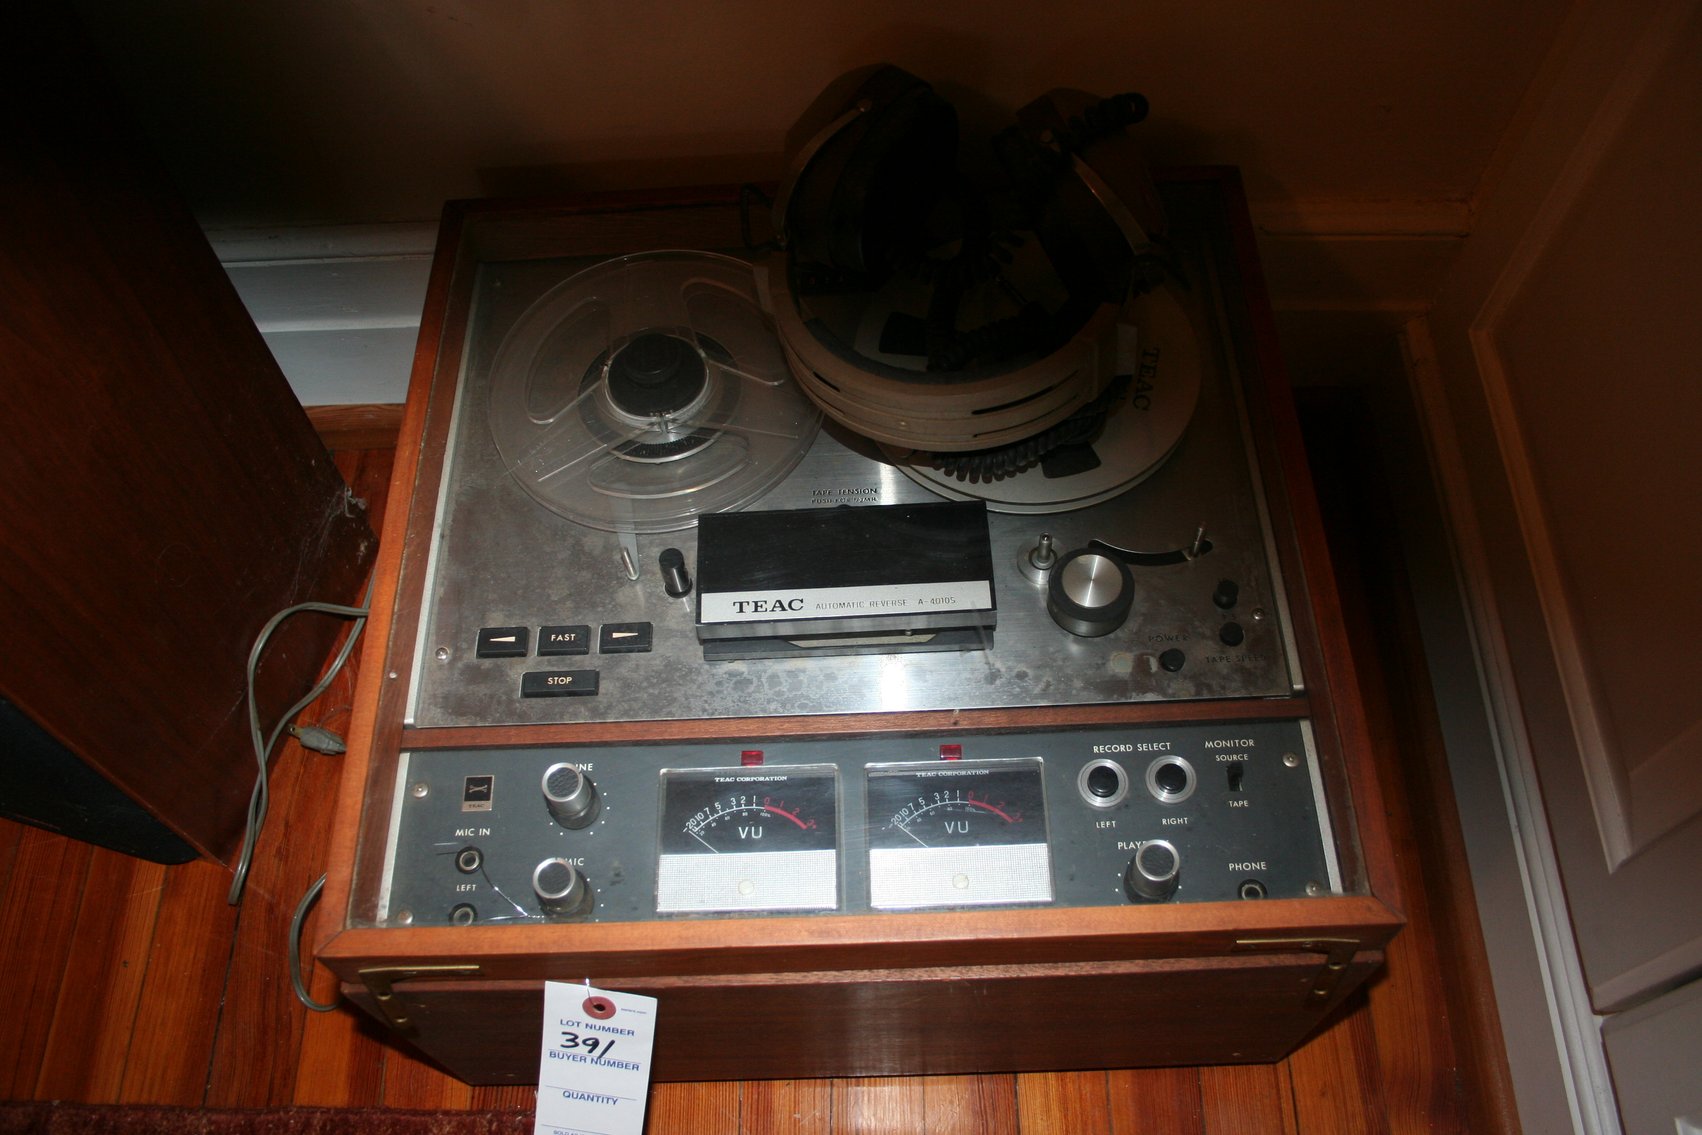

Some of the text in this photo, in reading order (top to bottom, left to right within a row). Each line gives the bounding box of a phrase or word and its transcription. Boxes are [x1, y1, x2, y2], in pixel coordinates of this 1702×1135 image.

[1133, 347, 1160, 411] TEAC
[811, 487, 878, 497] TAPE TENSION
[732, 597, 805, 614] TEAC
[815, 600, 865, 610] AUTOMATIC
[869, 599, 908, 608] REVERSE
[550, 633, 576, 642] FAST
[1149, 633, 1190, 643] POWER
[1205, 654, 1232, 664] TAPE
[547, 676, 573, 685] STOP
[1093, 742, 1171, 754] RECORD SELECT
[1204, 738, 1255, 749] MONITOR
[1215, 753, 1249, 762] SOURCE
[938, 769, 990, 777] CORPORATION
[694, 812, 705, 822] 10
[703, 807, 711, 815] 7
[714, 802, 722, 810] 5
[730, 797, 737, 805] 3
[740, 795, 746, 804] 2
[764, 797, 770, 805] 0
[900, 808, 909, 817] 10
[907, 802, 915, 811] 7
[918, 797, 925, 806] 5
[933, 792, 940, 800] 3
[943, 790, 950, 799] 2
[1095, 820, 1116, 829] LEFT
[1161, 817, 1188, 825] RIGHT
[454, 827, 491, 837] MIC IN
[944, 820, 969, 834] VU
[738, 826, 763, 839] VU
[1228, 861, 1267, 871] PHONE
[456, 884, 477, 892] LEFT
[559, 1018, 636, 1037] LOT NUMBER
[548, 1050, 640, 1072] BUYER NUMBER
[562, 1090, 619, 1106] QUANTITY
